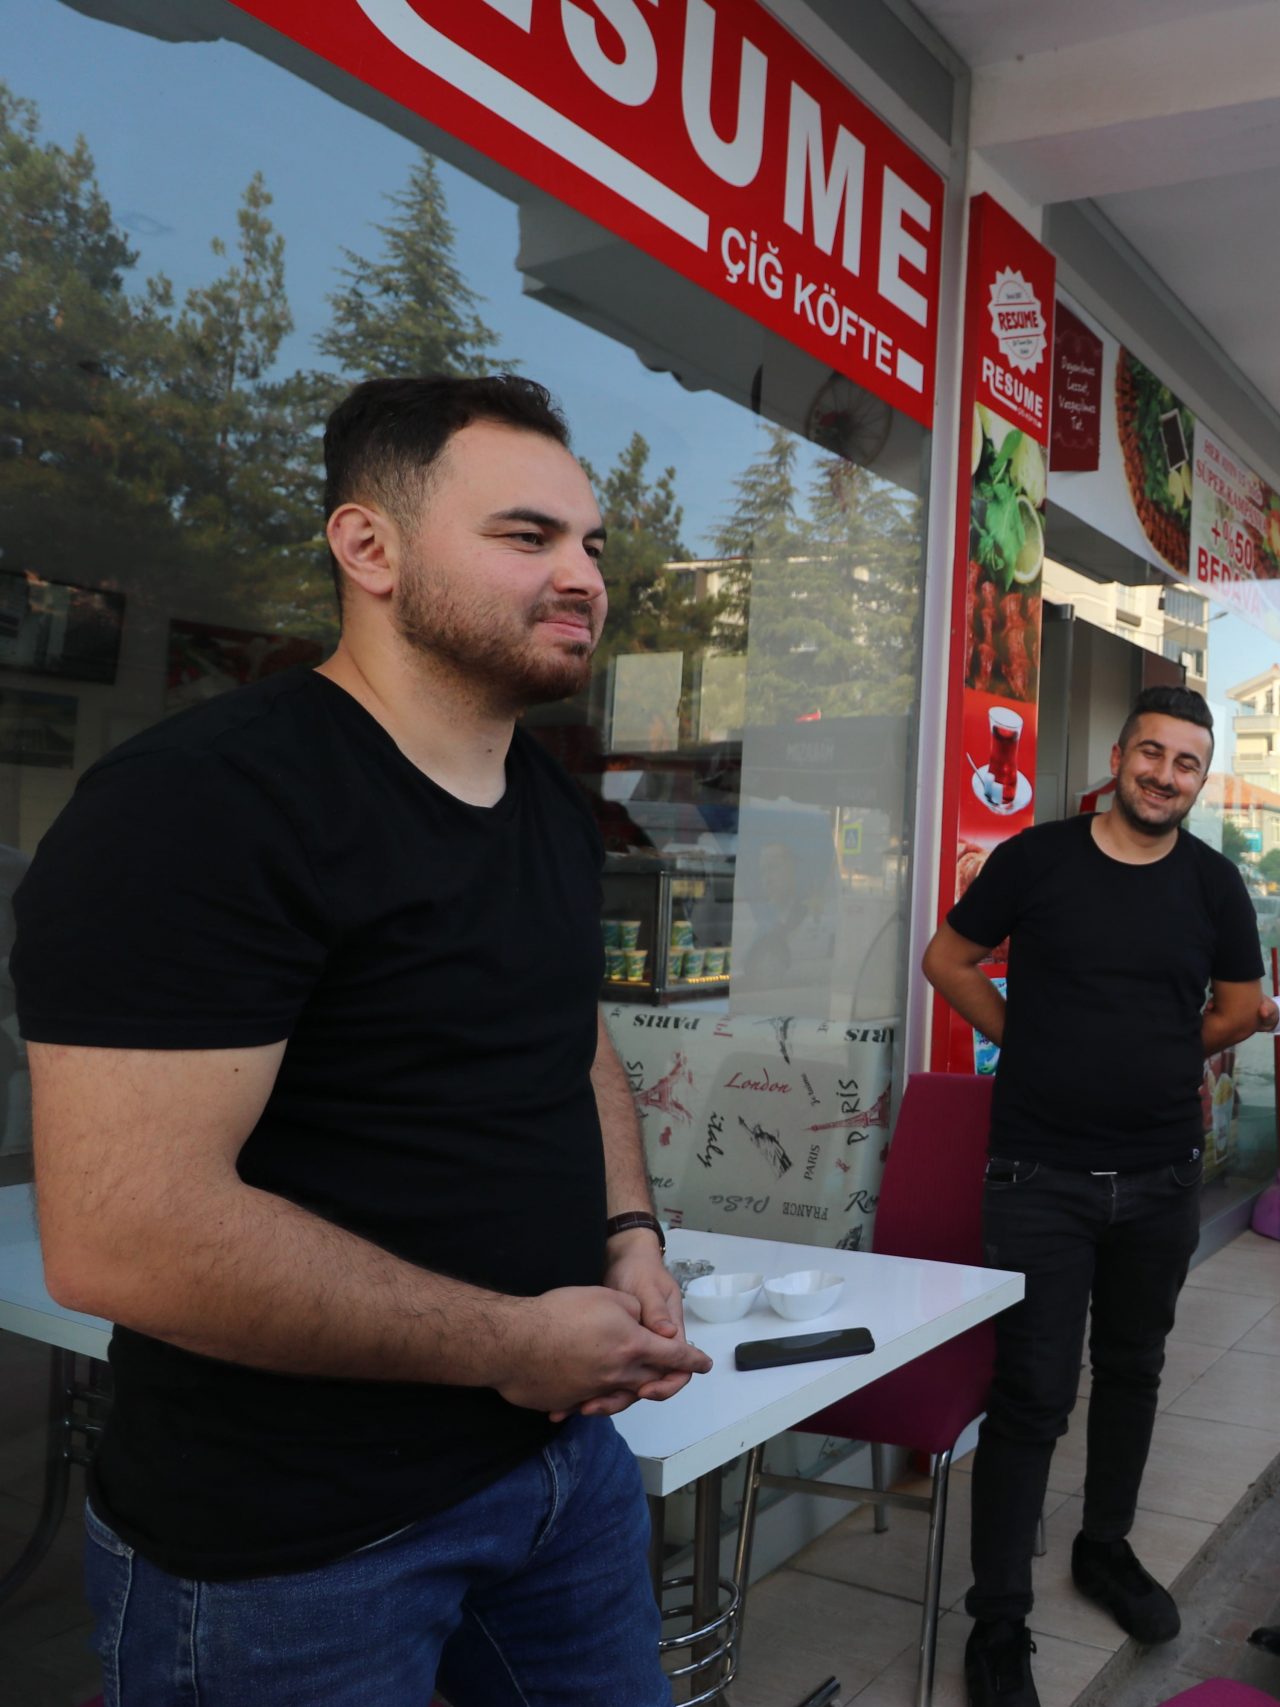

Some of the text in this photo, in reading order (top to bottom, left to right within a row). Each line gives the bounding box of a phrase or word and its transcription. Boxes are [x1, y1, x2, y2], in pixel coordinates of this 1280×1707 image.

[720, 227, 894, 376] ÇİĞ KÖFTE
[997, 310, 1039, 331] RESUME
[982, 356, 1044, 418] RESUME
[723, 1067, 792, 1094] London
[803, 1144, 821, 1181] PARIS
[782, 1201, 829, 1221] FRANCE
